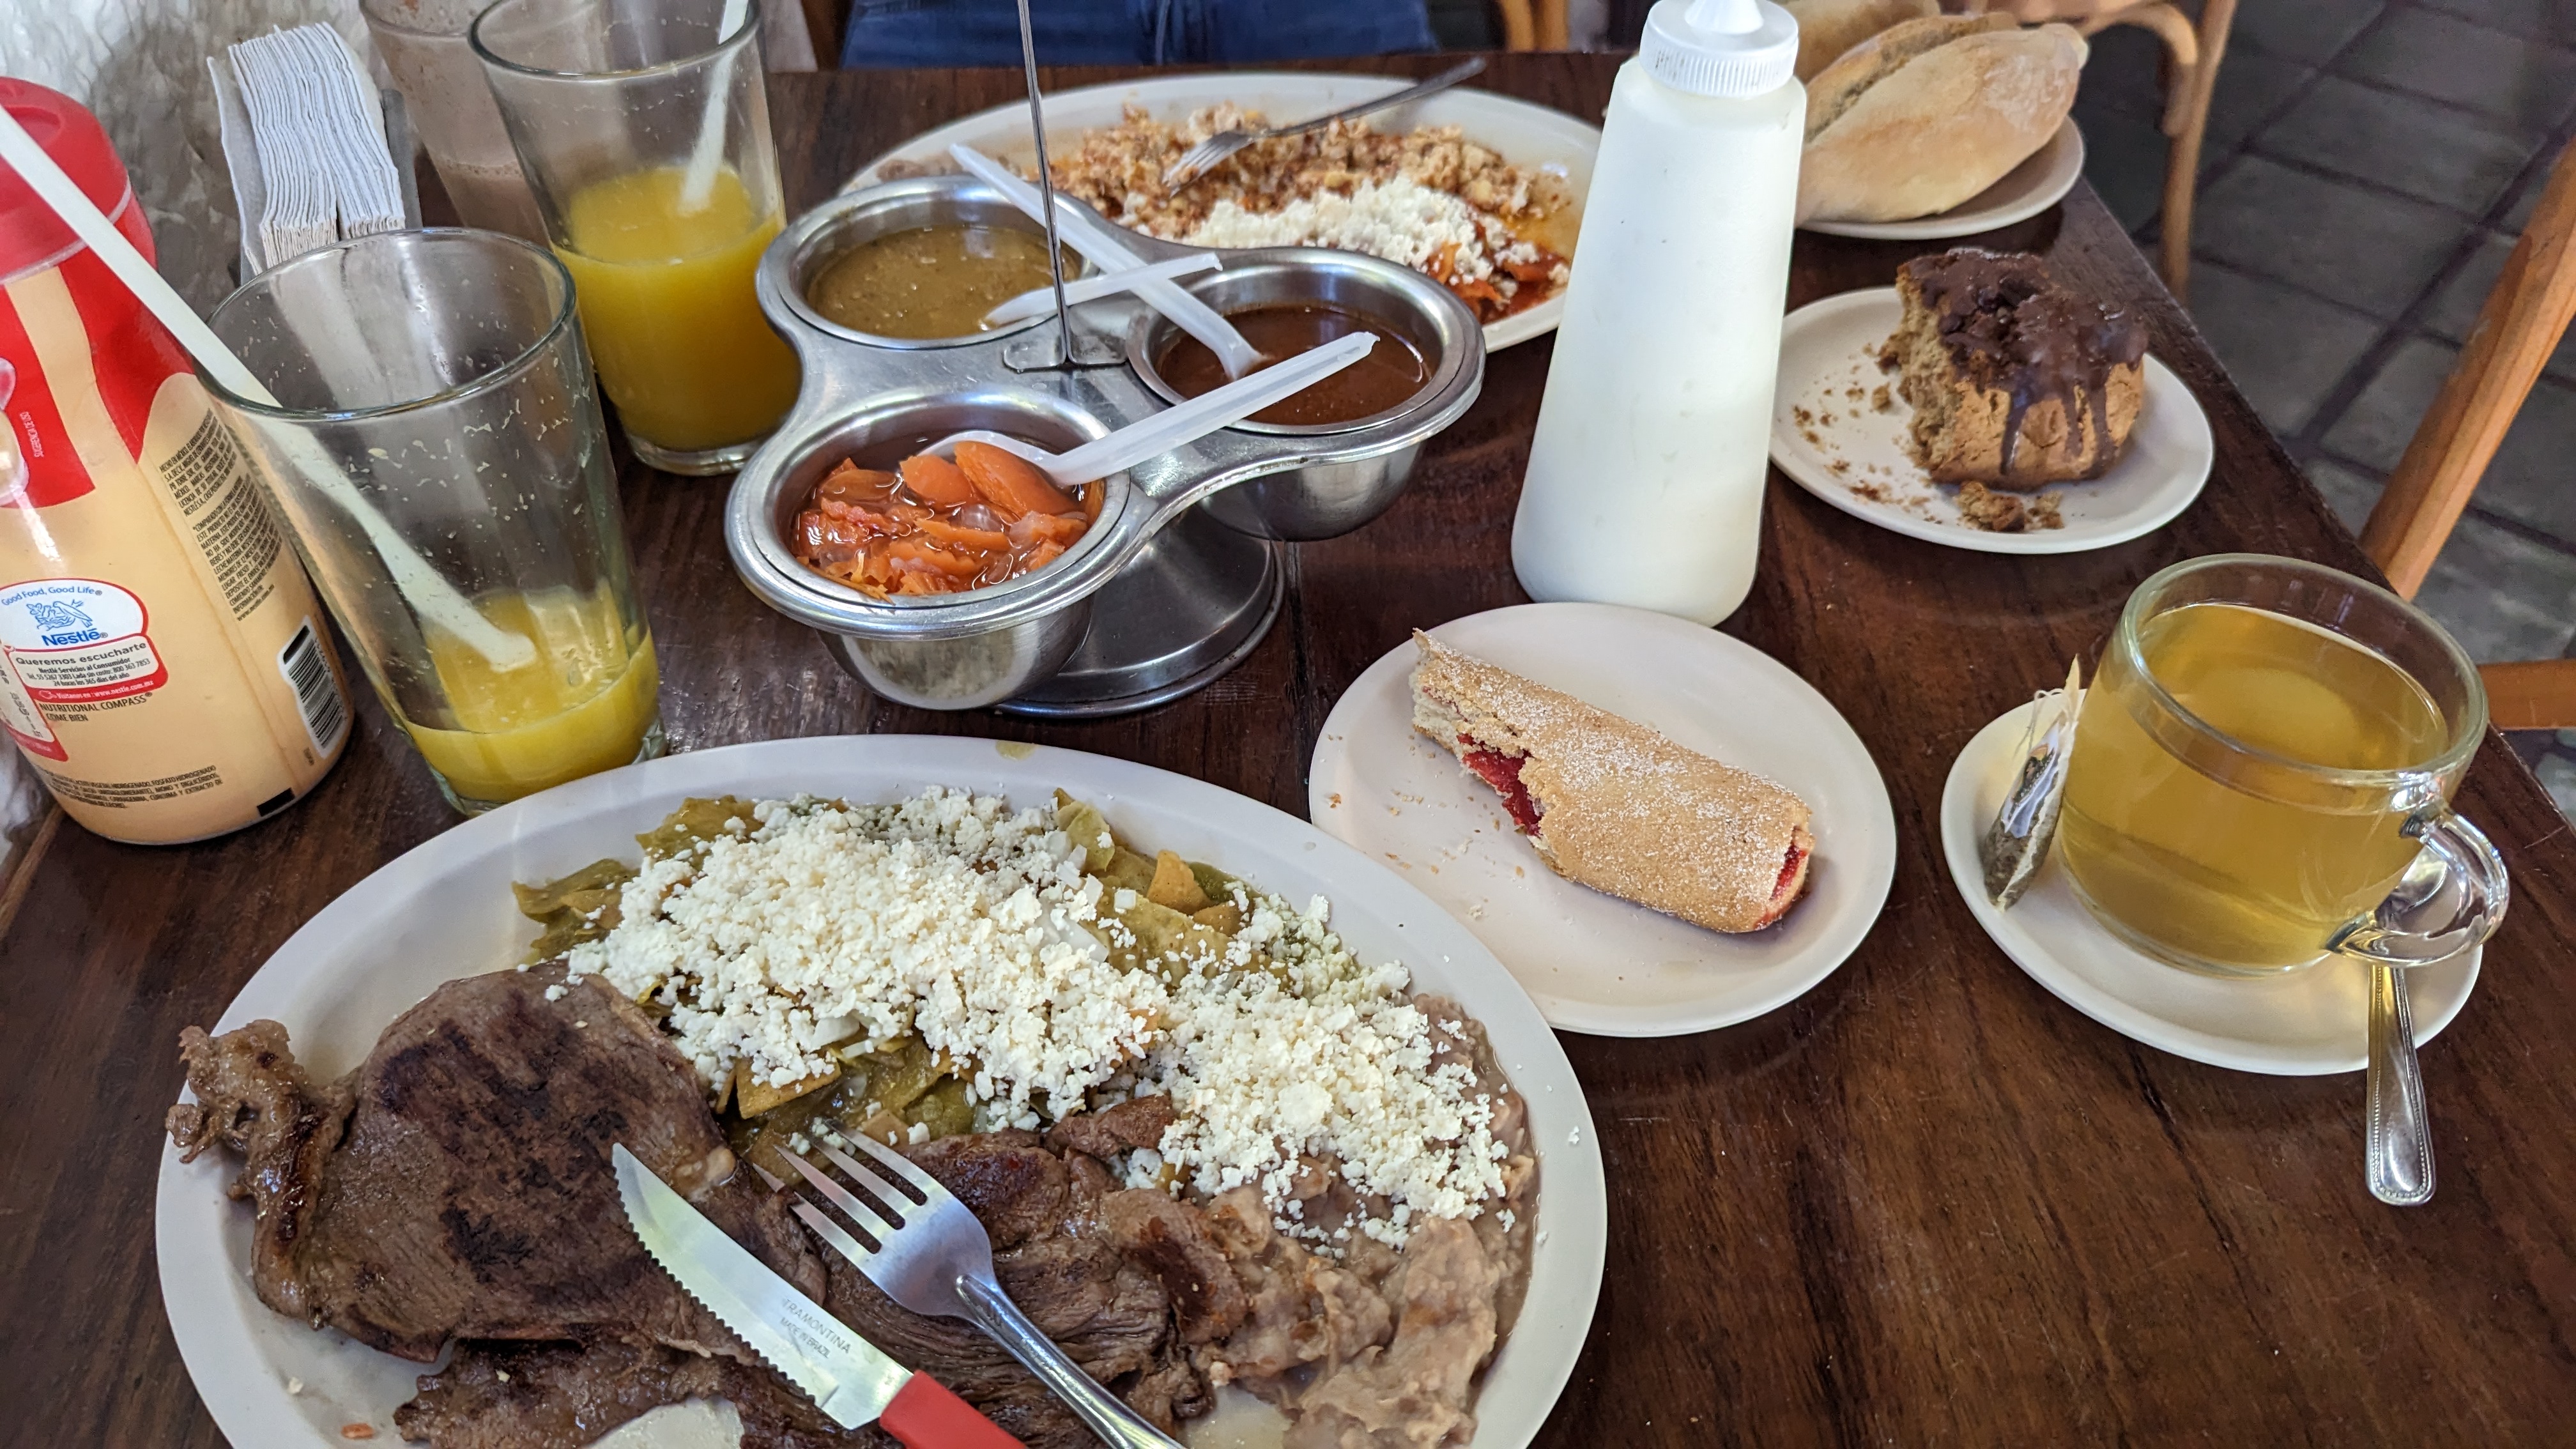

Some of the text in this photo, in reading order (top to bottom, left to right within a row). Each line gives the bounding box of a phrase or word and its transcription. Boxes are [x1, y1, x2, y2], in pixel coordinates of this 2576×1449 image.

[1, 594, 22, 606] Good
[16, 642, 146, 665] Queremos escucharte
[93, 657, 130, 670] Consumidor
[39, 703, 98, 713] NUTRITIONAL
[46, 713, 88, 722] COME BIEN
[783, 1299, 851, 1354] TRAMONTINA
